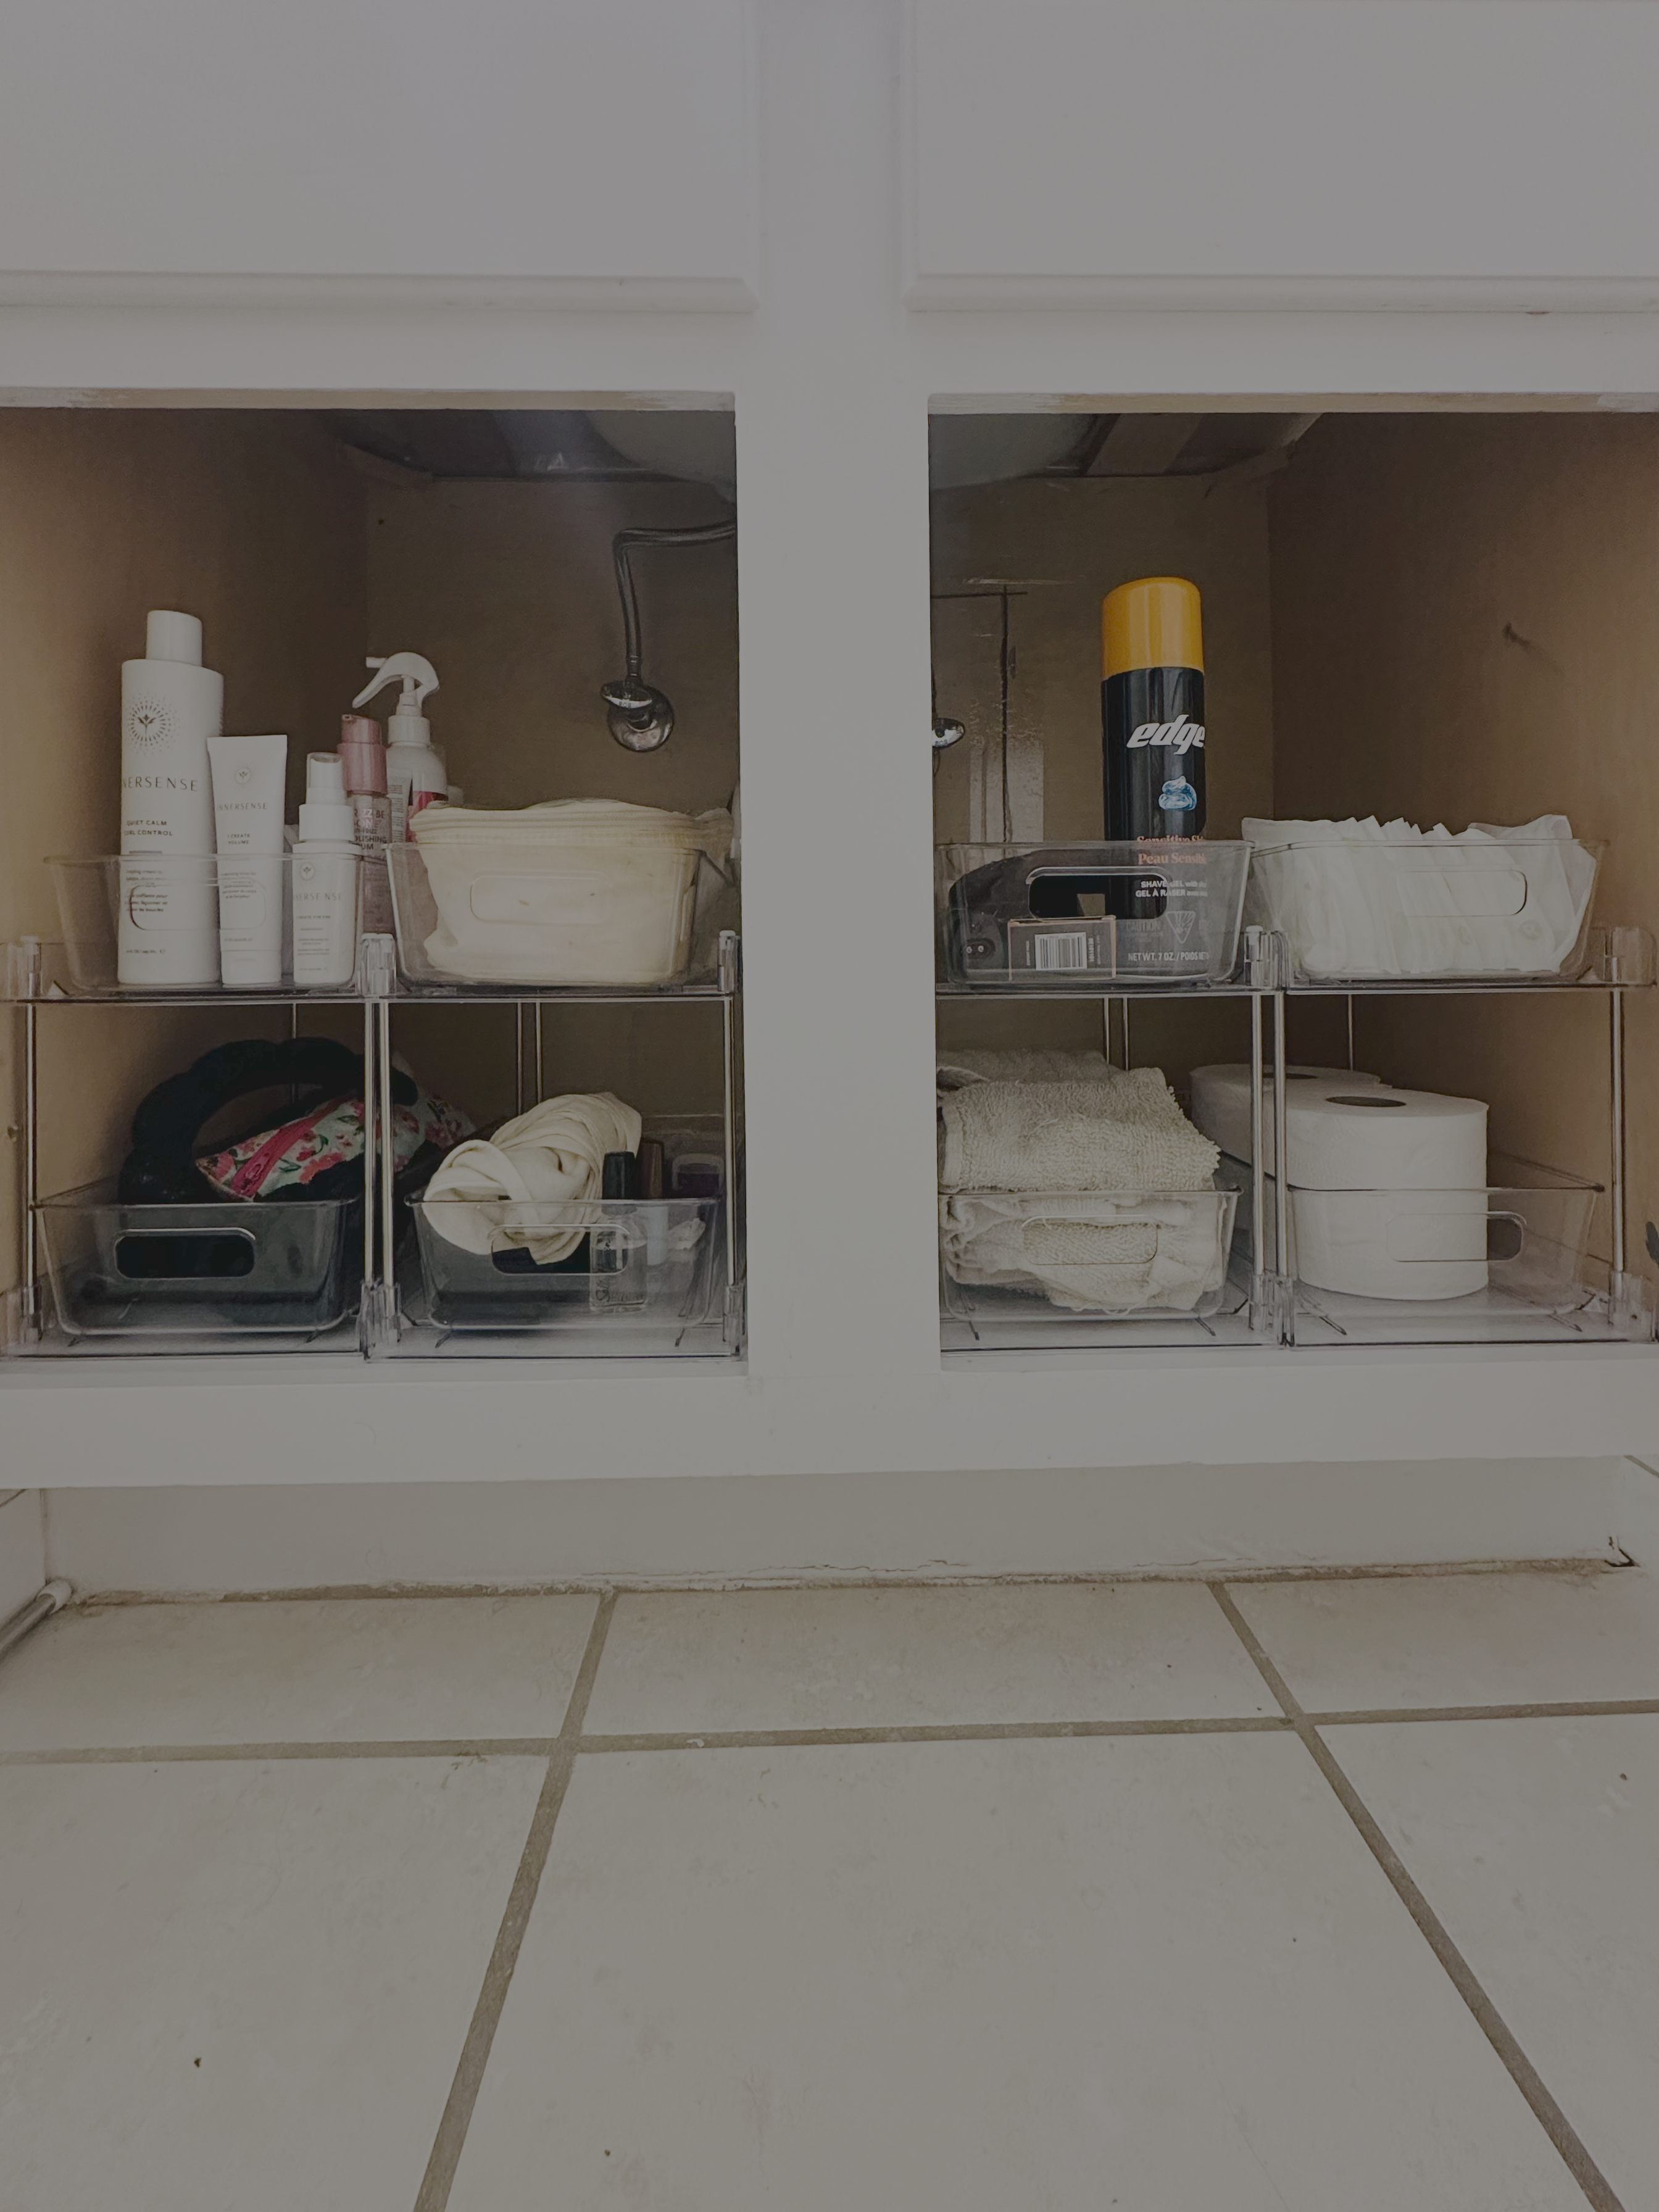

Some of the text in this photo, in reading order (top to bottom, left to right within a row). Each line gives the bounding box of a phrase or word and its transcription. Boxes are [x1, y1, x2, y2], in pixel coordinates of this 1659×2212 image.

[1126, 713, 1205, 755] edge
[217, 802, 267, 812] INNERSENSE
[375, 809, 386, 819] BE
[1137, 853, 1169, 865] Peau
[1141, 880, 1168, 888] SHAVE
[1169, 879, 1184, 888] GEL
[1152, 888, 1159, 897] À
[1160, 889, 1186, 897] RASER
[1128, 952, 1142, 961] NET
[1181, 951, 1197, 961] POIDS
